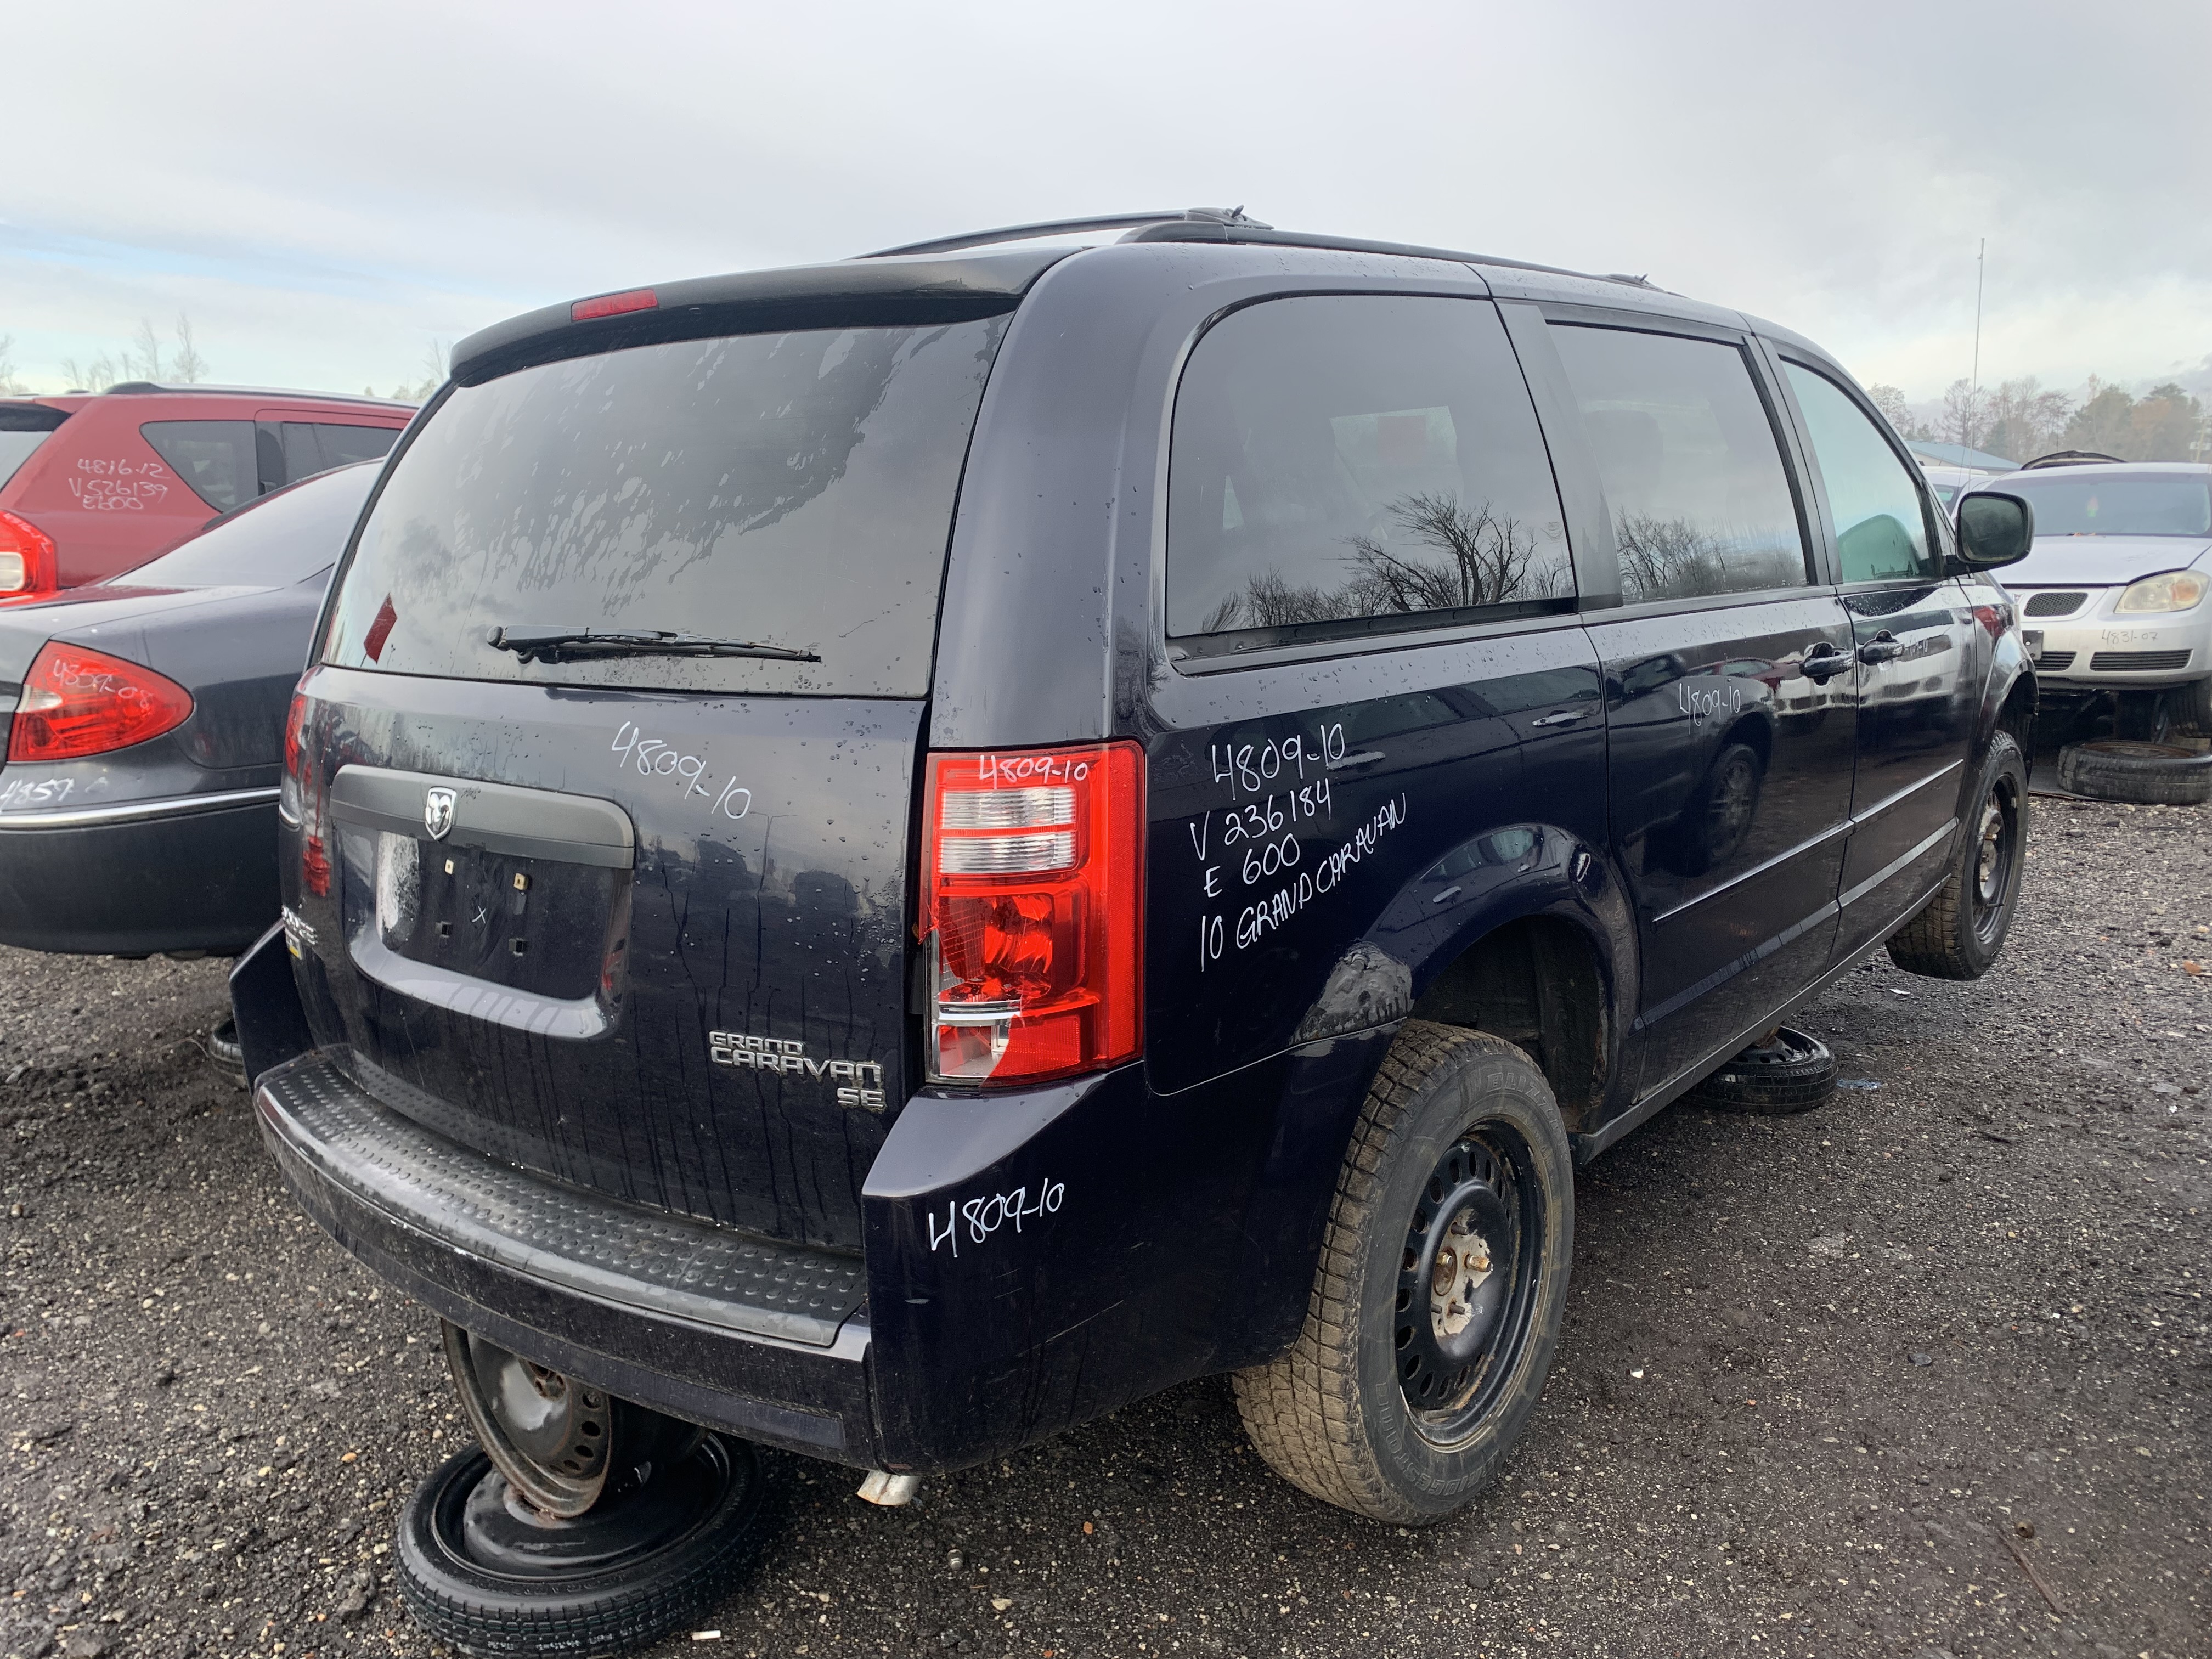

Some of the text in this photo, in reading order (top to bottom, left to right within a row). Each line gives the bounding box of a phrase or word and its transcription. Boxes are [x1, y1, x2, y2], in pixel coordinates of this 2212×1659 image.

[2102, 629, 2158, 645] 4831-07
[1679, 682, 1741, 735] 4809-10
[612, 721, 752, 819] 4809-10
[979, 754, 1088, 790] 4809-10
[1212, 723, 1346, 801] 4809-10
[1190, 778, 1331, 861] V 236184
[1203, 833, 1300, 898] E 600
[1201, 915, 1223, 973] 10
[709, 1031, 803, 1056] GRAND
[710, 1046, 881, 1082] CARAVAN
[837, 1087, 884, 1107] SE
[928, 1177, 1065, 1259] 4809-10
